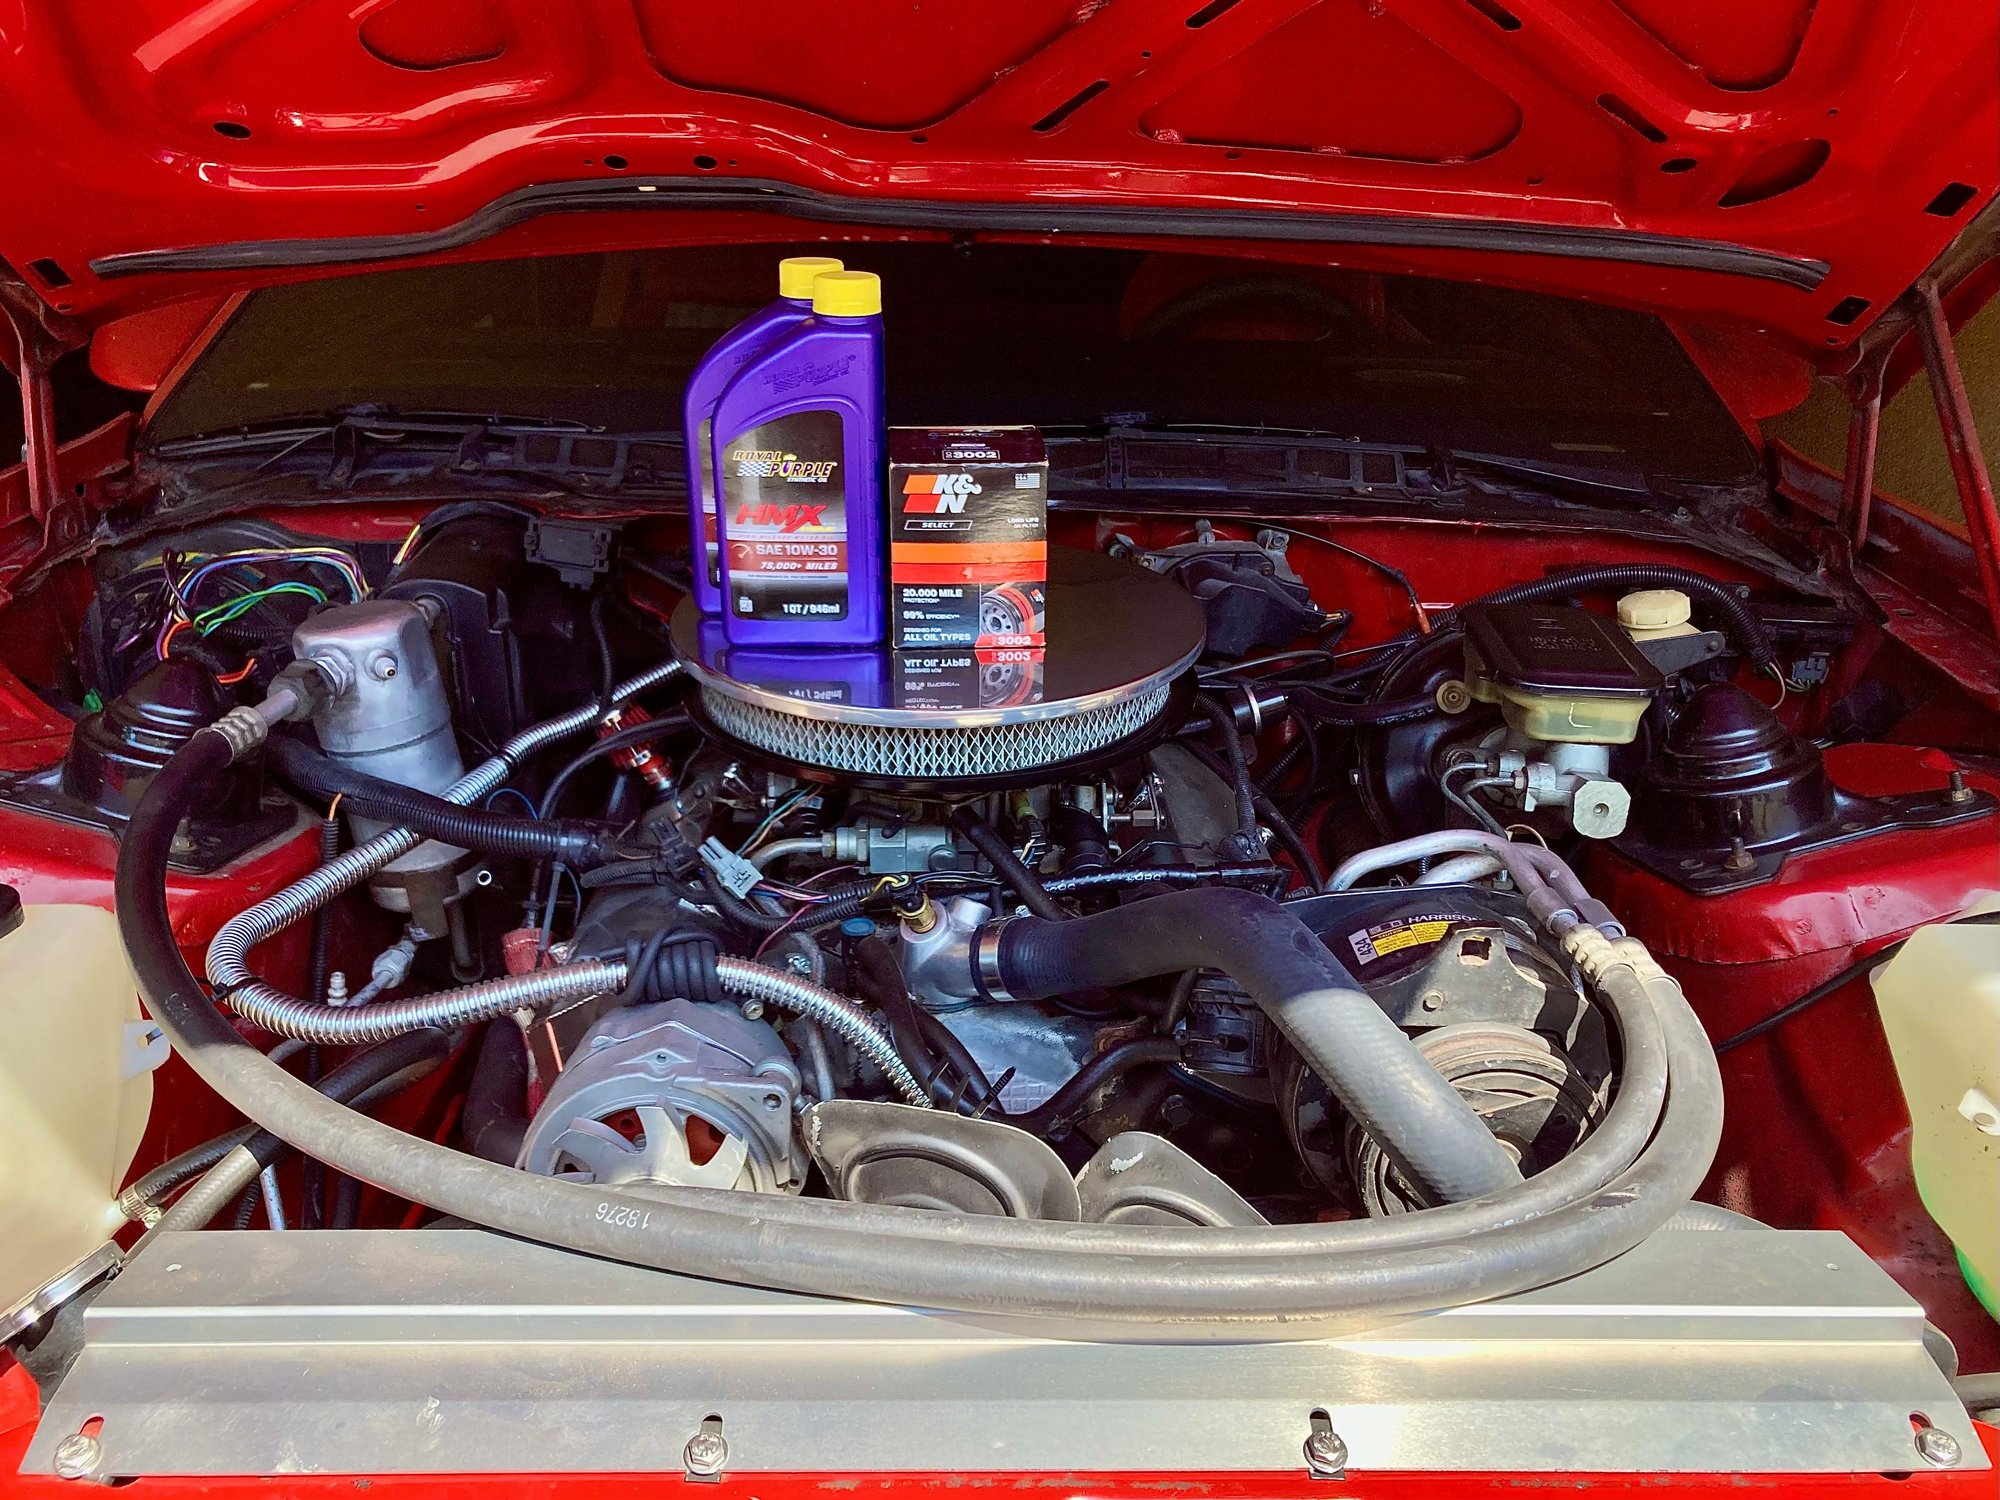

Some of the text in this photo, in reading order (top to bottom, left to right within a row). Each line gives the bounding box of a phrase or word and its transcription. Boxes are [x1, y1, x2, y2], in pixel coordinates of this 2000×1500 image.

[732, 450, 783, 462] ROYAL
[952, 451, 998, 459] 3002
[767, 461, 833, 478] PURPLE
[735, 503, 828, 533] HMX
[756, 544, 838, 556] SAE 10W-30
[760, 561, 839, 571] 75,000+ MILES
[939, 589, 963, 597] MILE
[903, 611, 925, 620] 99%
[903, 633, 972, 641] ALL OIL TYPES
[997, 636, 1032, 645] 3002
[1354, 937, 1373, 956] 434
